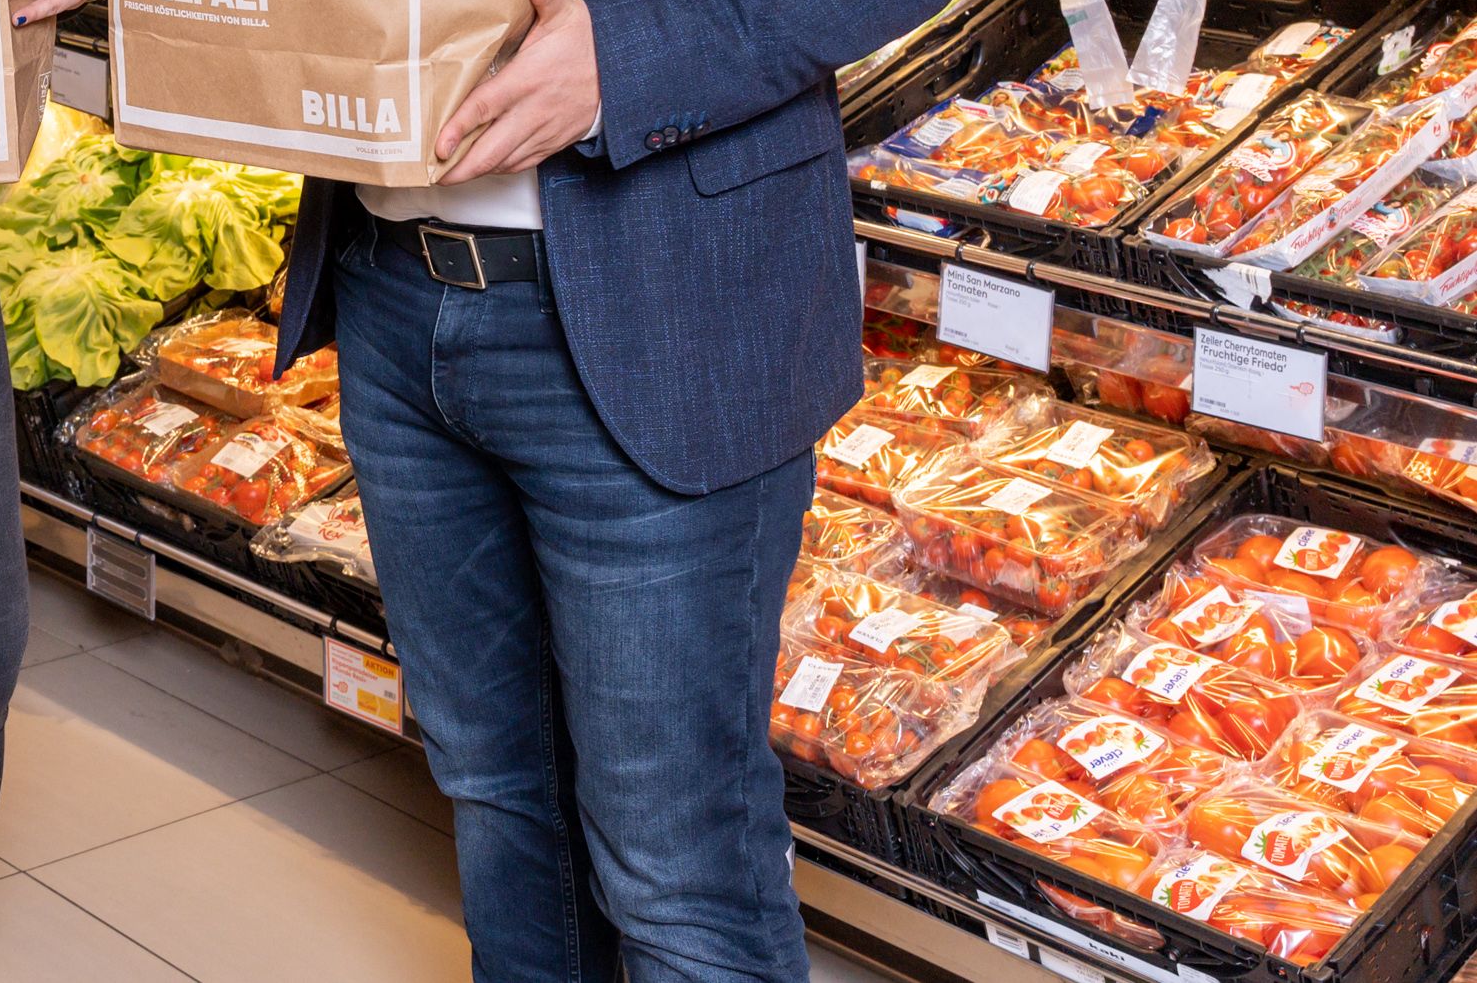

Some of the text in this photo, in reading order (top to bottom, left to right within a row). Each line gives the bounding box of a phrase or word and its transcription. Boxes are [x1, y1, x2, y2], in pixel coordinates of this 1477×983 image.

[124, 0, 269, 28] FRISCHE KÖSTLICHKEITEN VON BILLA.
[301, 89, 401, 133] BILLA
[1291, 224, 1325, 251] Fruchtige
[948, 269, 1020, 298] Mini San Marzano
[948, 280, 988, 298] Tomaten
[1201, 334, 1287, 362] Zeiler Cherrytomaten
[365, 660, 395, 677] AKTION
[1163, 668, 1189, 695] clever
[1390, 659, 1417, 679] clever
[1336, 729, 1365, 751] clever
[1091, 748, 1123, 769] clever
[1177, 881, 1194, 911] TOMATEN
[1088, 942, 1126, 963] kaki
